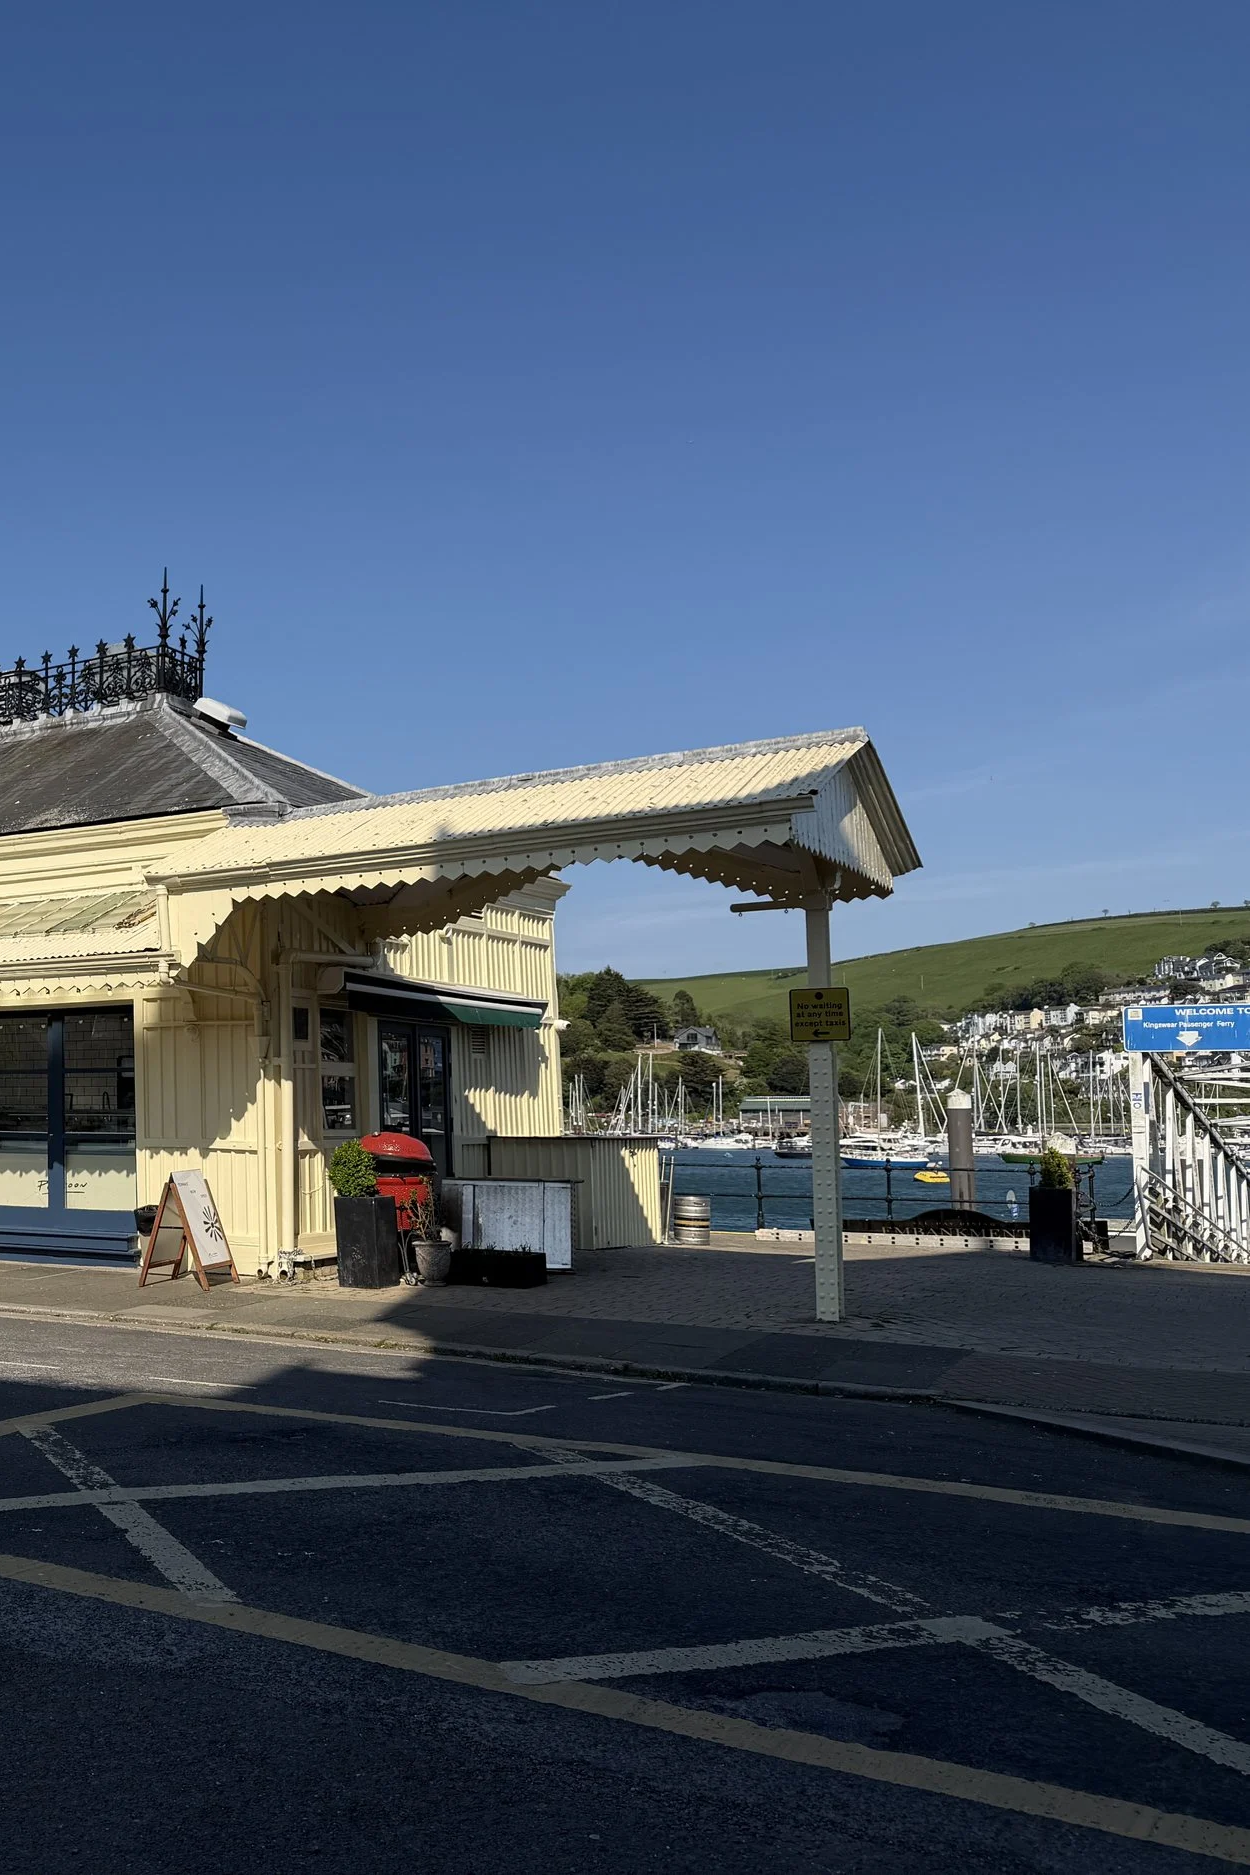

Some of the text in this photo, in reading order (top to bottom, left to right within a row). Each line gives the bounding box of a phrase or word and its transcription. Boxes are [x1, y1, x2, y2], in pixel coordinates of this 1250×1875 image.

[797, 1002, 843, 1010] No waiting
[1174, 1007, 1234, 1016] WELCOME
[795, 1020, 823, 1028] except
[1143, 1020, 1235, 1029] Kingswear Passenger Ferry
